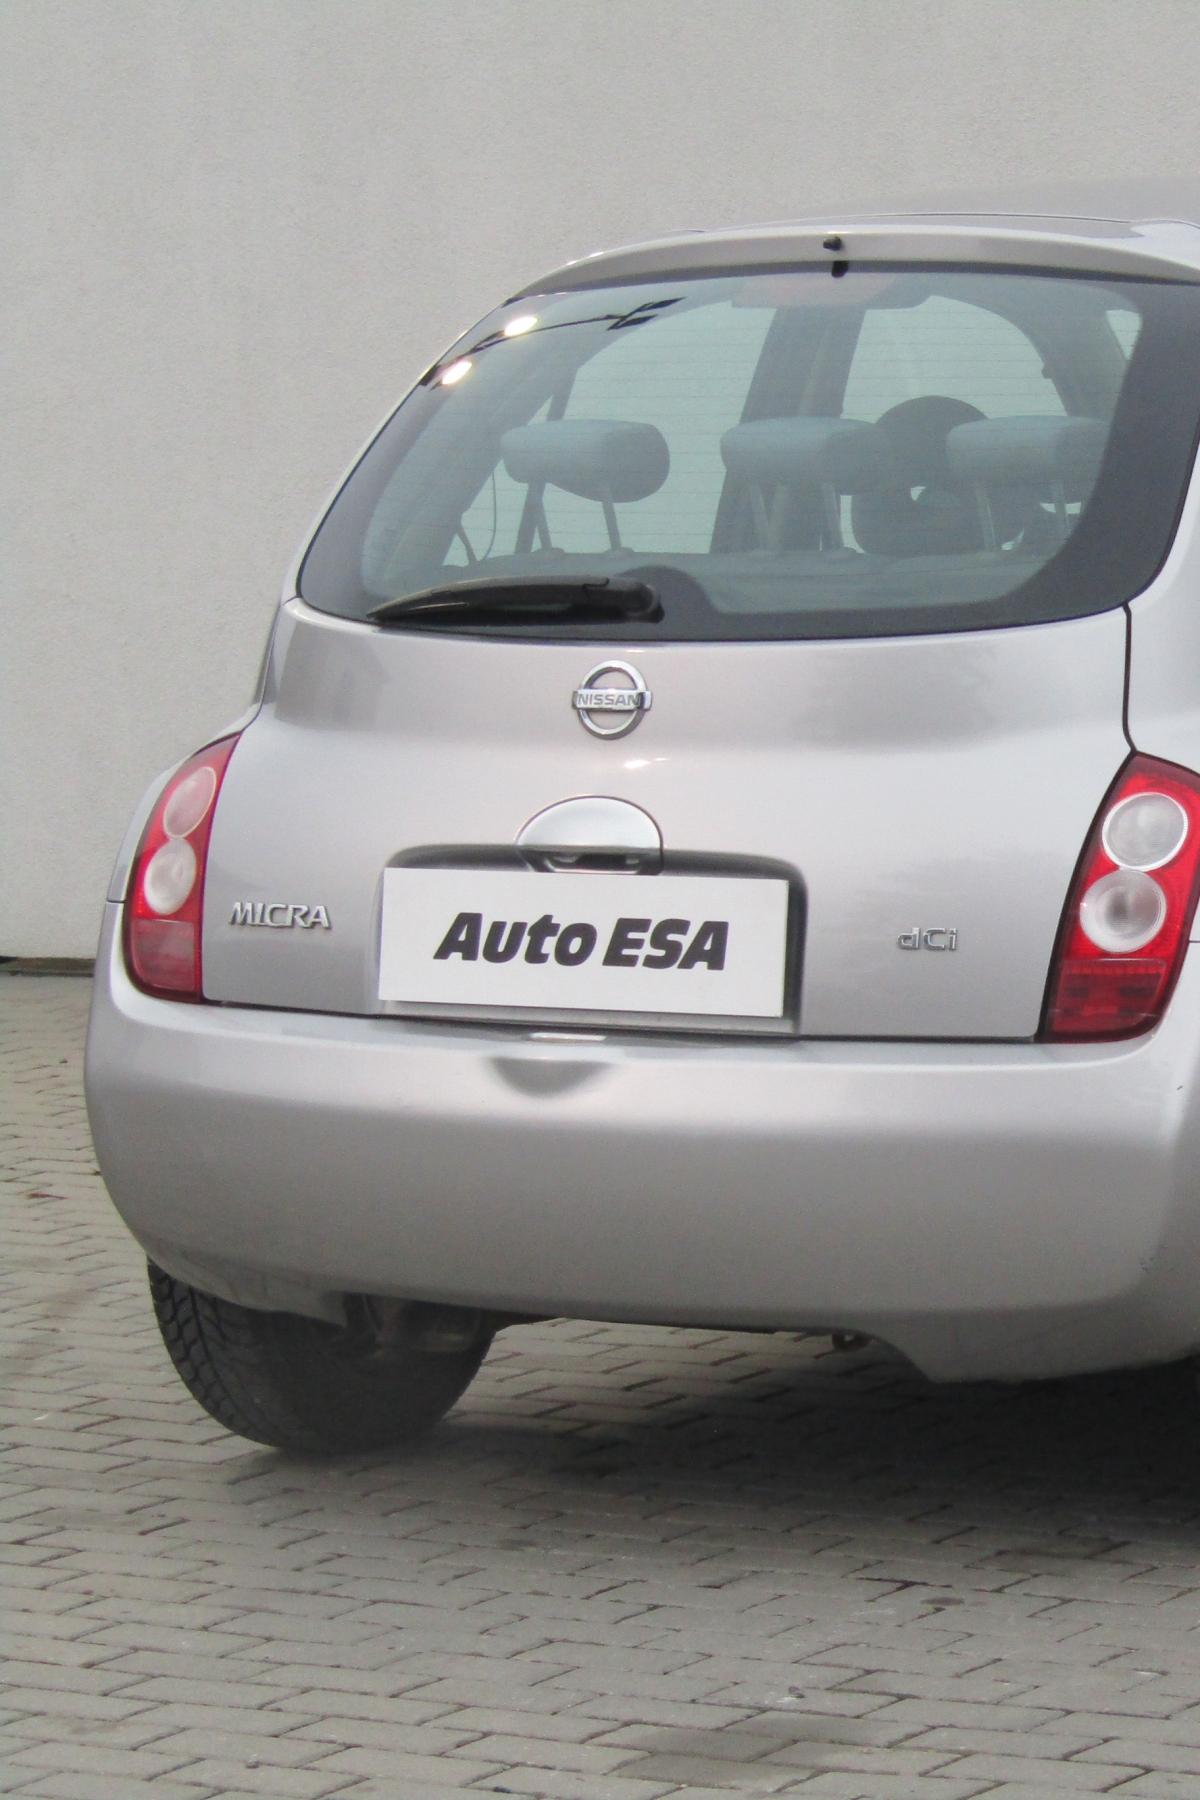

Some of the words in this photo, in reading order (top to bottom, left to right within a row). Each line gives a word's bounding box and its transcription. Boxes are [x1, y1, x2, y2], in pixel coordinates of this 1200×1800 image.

[577, 693, 640, 706] NISSAN
[229, 902, 331, 929] MICRA
[433, 912, 598, 967] Auto
[602, 917, 729, 971] ESA
[897, 927, 957, 951] dCi
